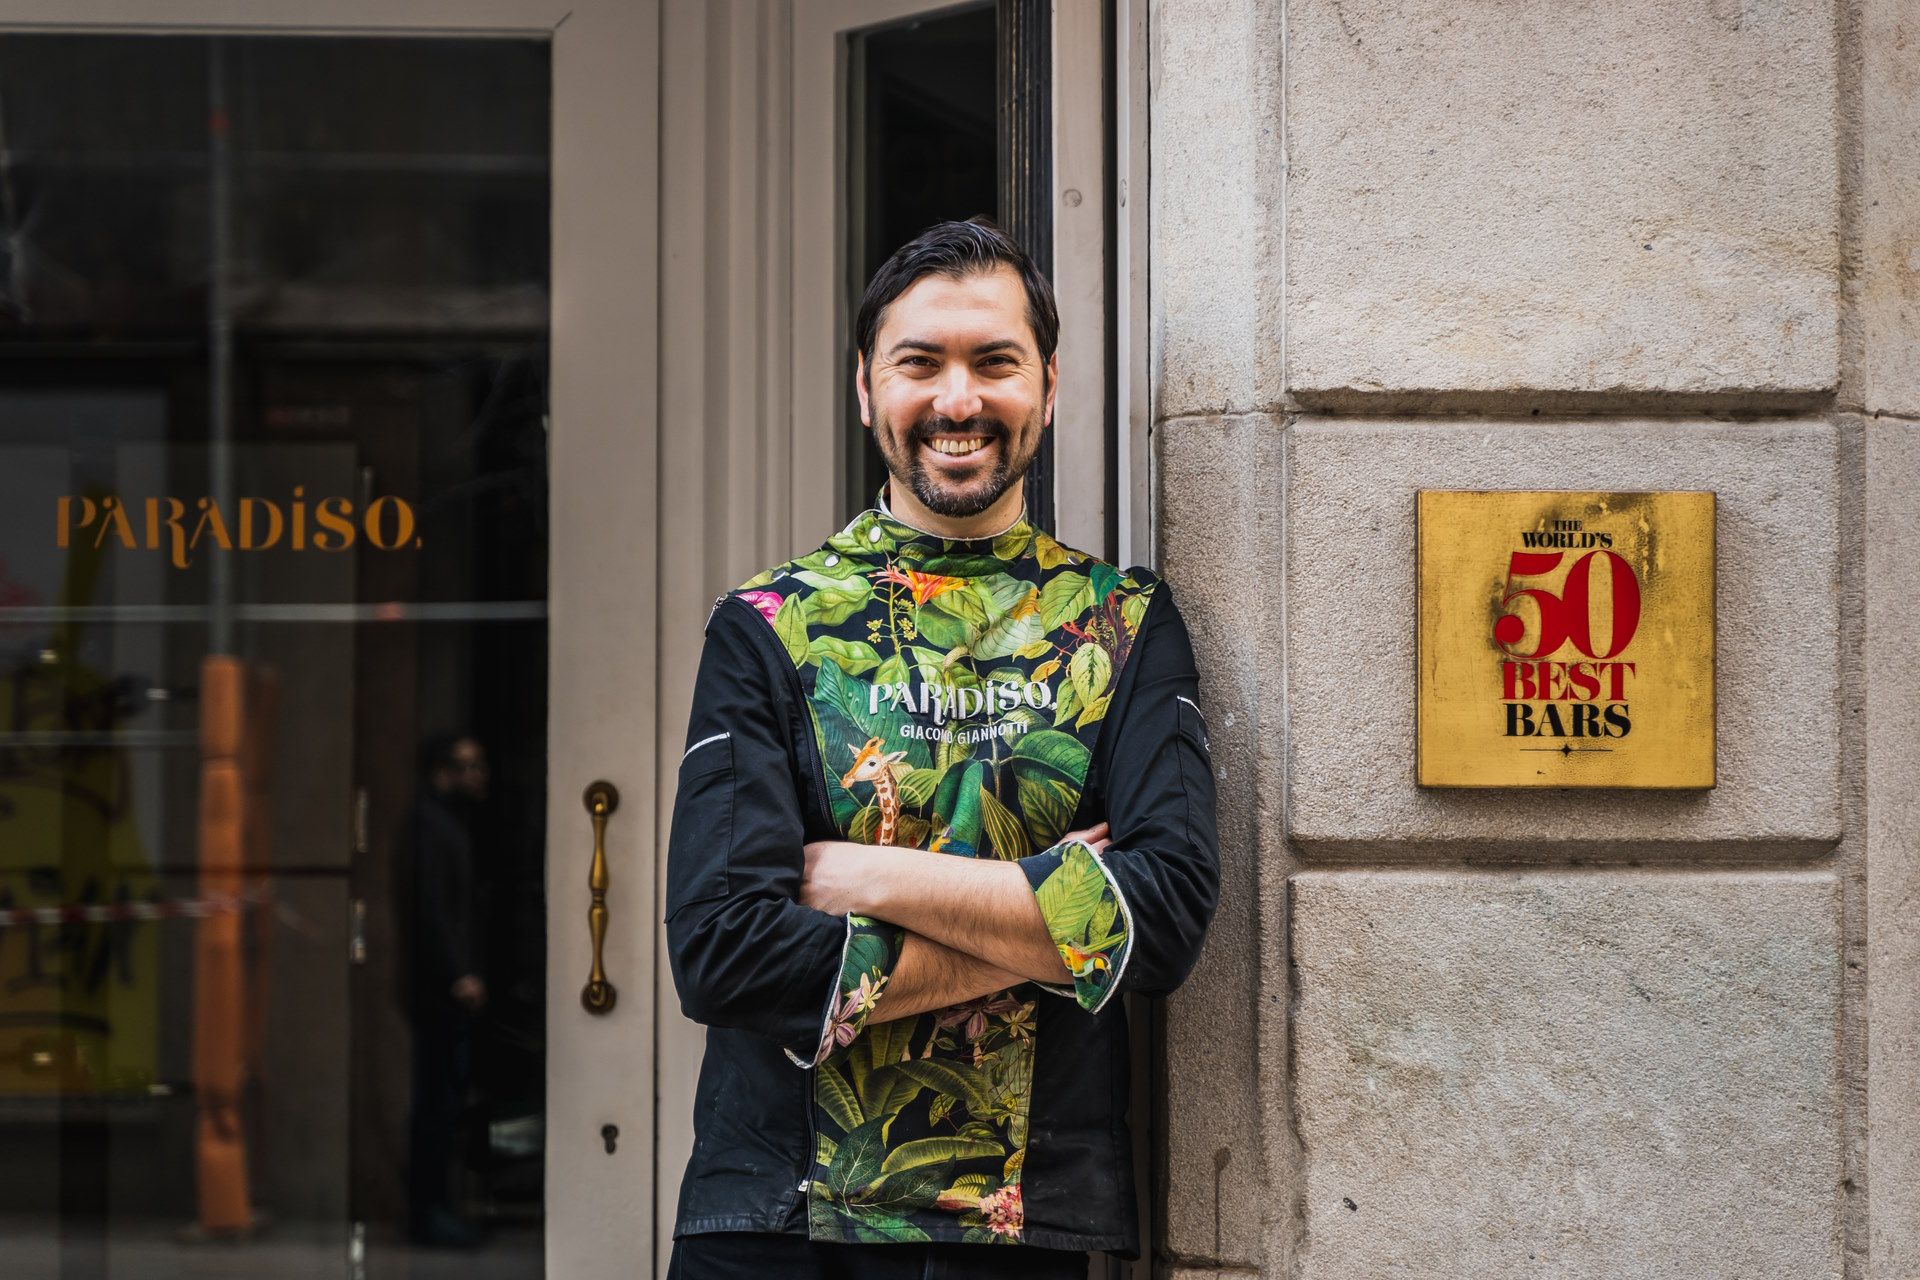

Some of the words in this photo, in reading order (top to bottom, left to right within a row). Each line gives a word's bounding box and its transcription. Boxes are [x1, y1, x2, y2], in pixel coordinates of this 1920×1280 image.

[1521, 531, 1614, 549] WORLD'S
[1552, 519, 1583, 532] THE
[1494, 549, 1641, 660] 50
[1501, 661, 1637, 701] BEST
[957, 721, 1028, 744] GIANNOTTI
[1502, 702, 1633, 739] BARS
